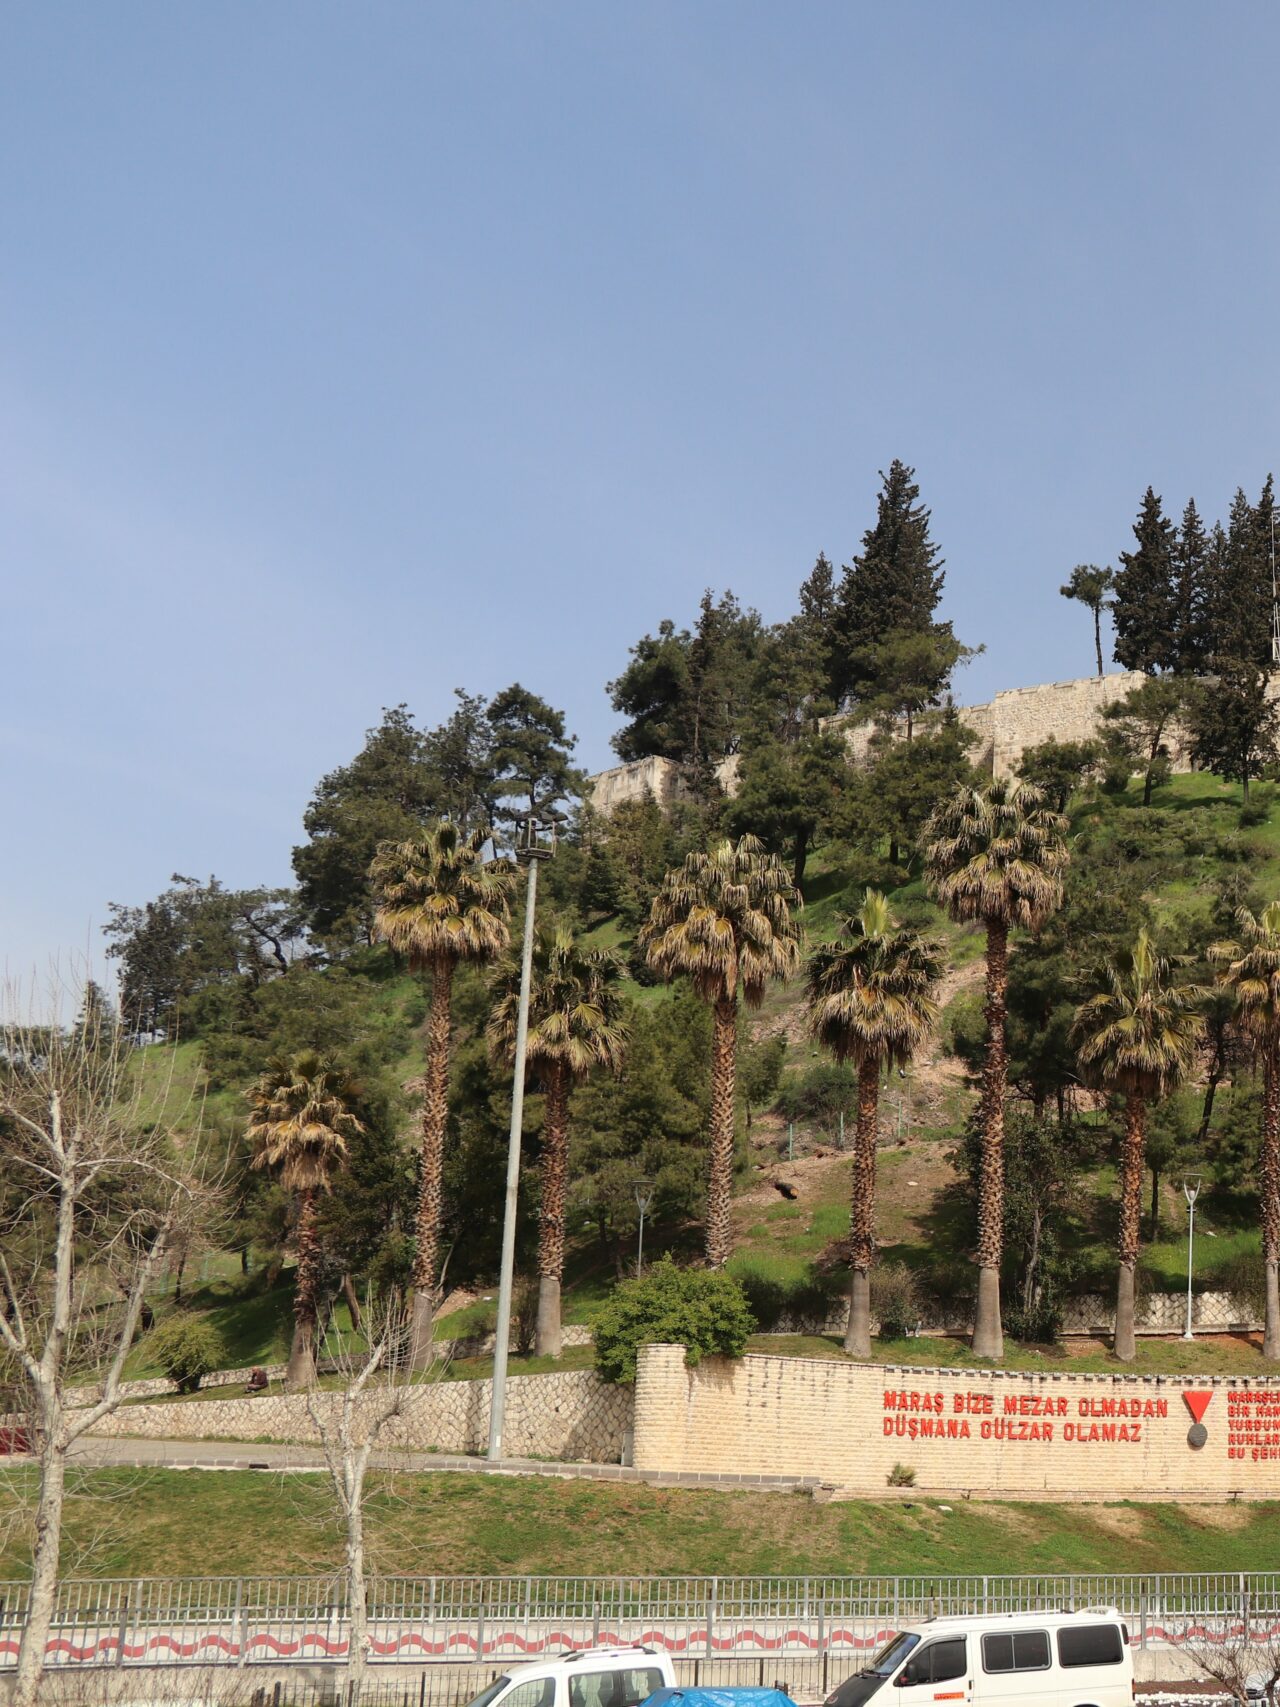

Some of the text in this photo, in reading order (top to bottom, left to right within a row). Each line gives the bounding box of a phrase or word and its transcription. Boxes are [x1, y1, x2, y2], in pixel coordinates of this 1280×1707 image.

[883, 1391, 1168, 1417] MARAŞ BİZE MEZAR OLMADAN
[884, 1414, 1141, 1441] DÜŞMANA GÜLZAR OLAMAZ
[1228, 1447, 1245, 1459] BU
